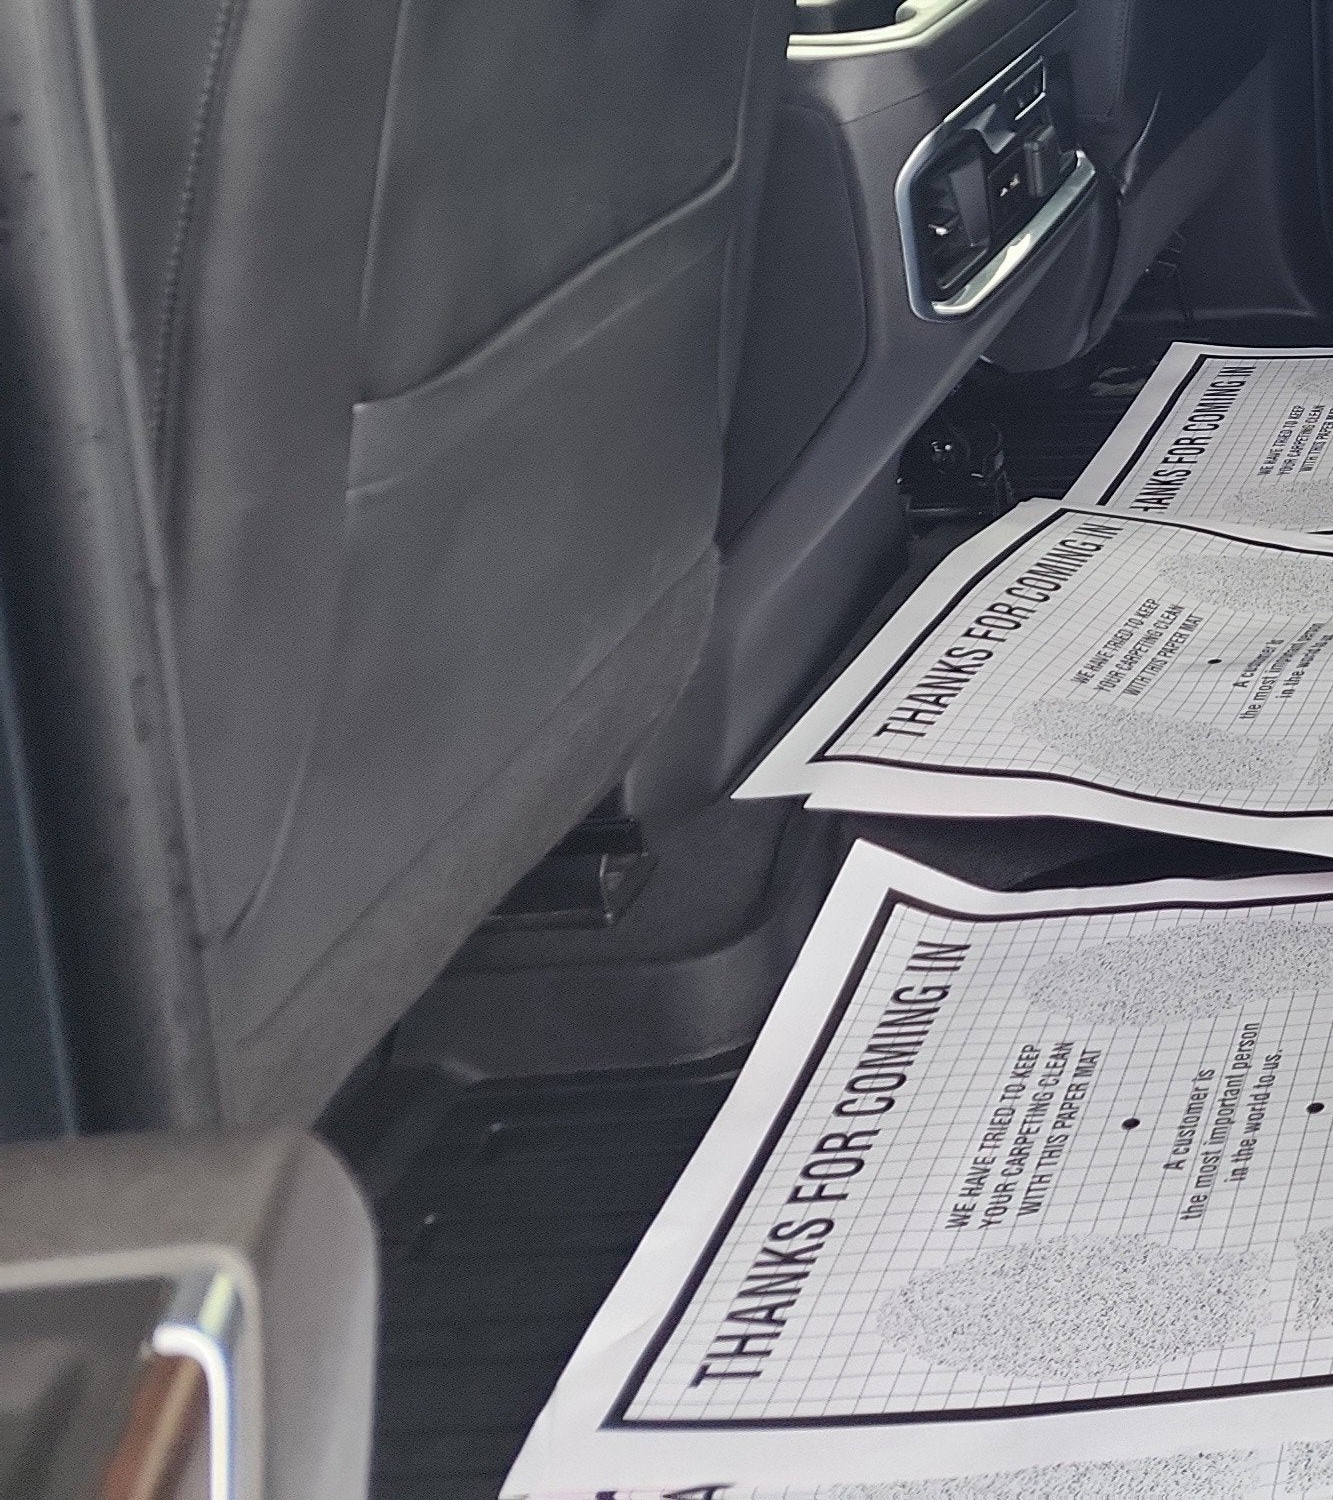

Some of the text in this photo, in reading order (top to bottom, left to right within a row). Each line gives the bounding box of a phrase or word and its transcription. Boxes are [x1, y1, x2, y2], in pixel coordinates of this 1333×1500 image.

[1128, 366, 1256, 514] HANKS FOR COMING IN
[873, 522, 1123, 738] THANKS FOR COMING IN
[1070, 598, 1160, 684] WE HAVE TRIED TO KEEP
[1094, 604, 1185, 692] YOUR CARPETING CLEAN
[1122, 613, 1203, 695] WITH THIS PAPER MAT
[1232, 680, 1250, 688] A
[1283, 670, 1305, 686] the
[1239, 703, 1261, 719] the
[1253, 675, 1278, 701] most
[1275, 688, 1295, 698] in
[690, 941, 972, 1388] THANKS FOR COMING IN
[945, 1044, 1041, 1229] WE HAVE TRIED TO KEEP
[978, 1041, 1075, 1229] YOUR CARPETING CLEAN
[1017, 1049, 1102, 1216] WITH THIS PAPER MAT
[1163, 1069, 1215, 1170] A customer is
[1180, 1022, 1260, 1220] the most important person
[1224, 1049, 1283, 1182] in the world to us.
